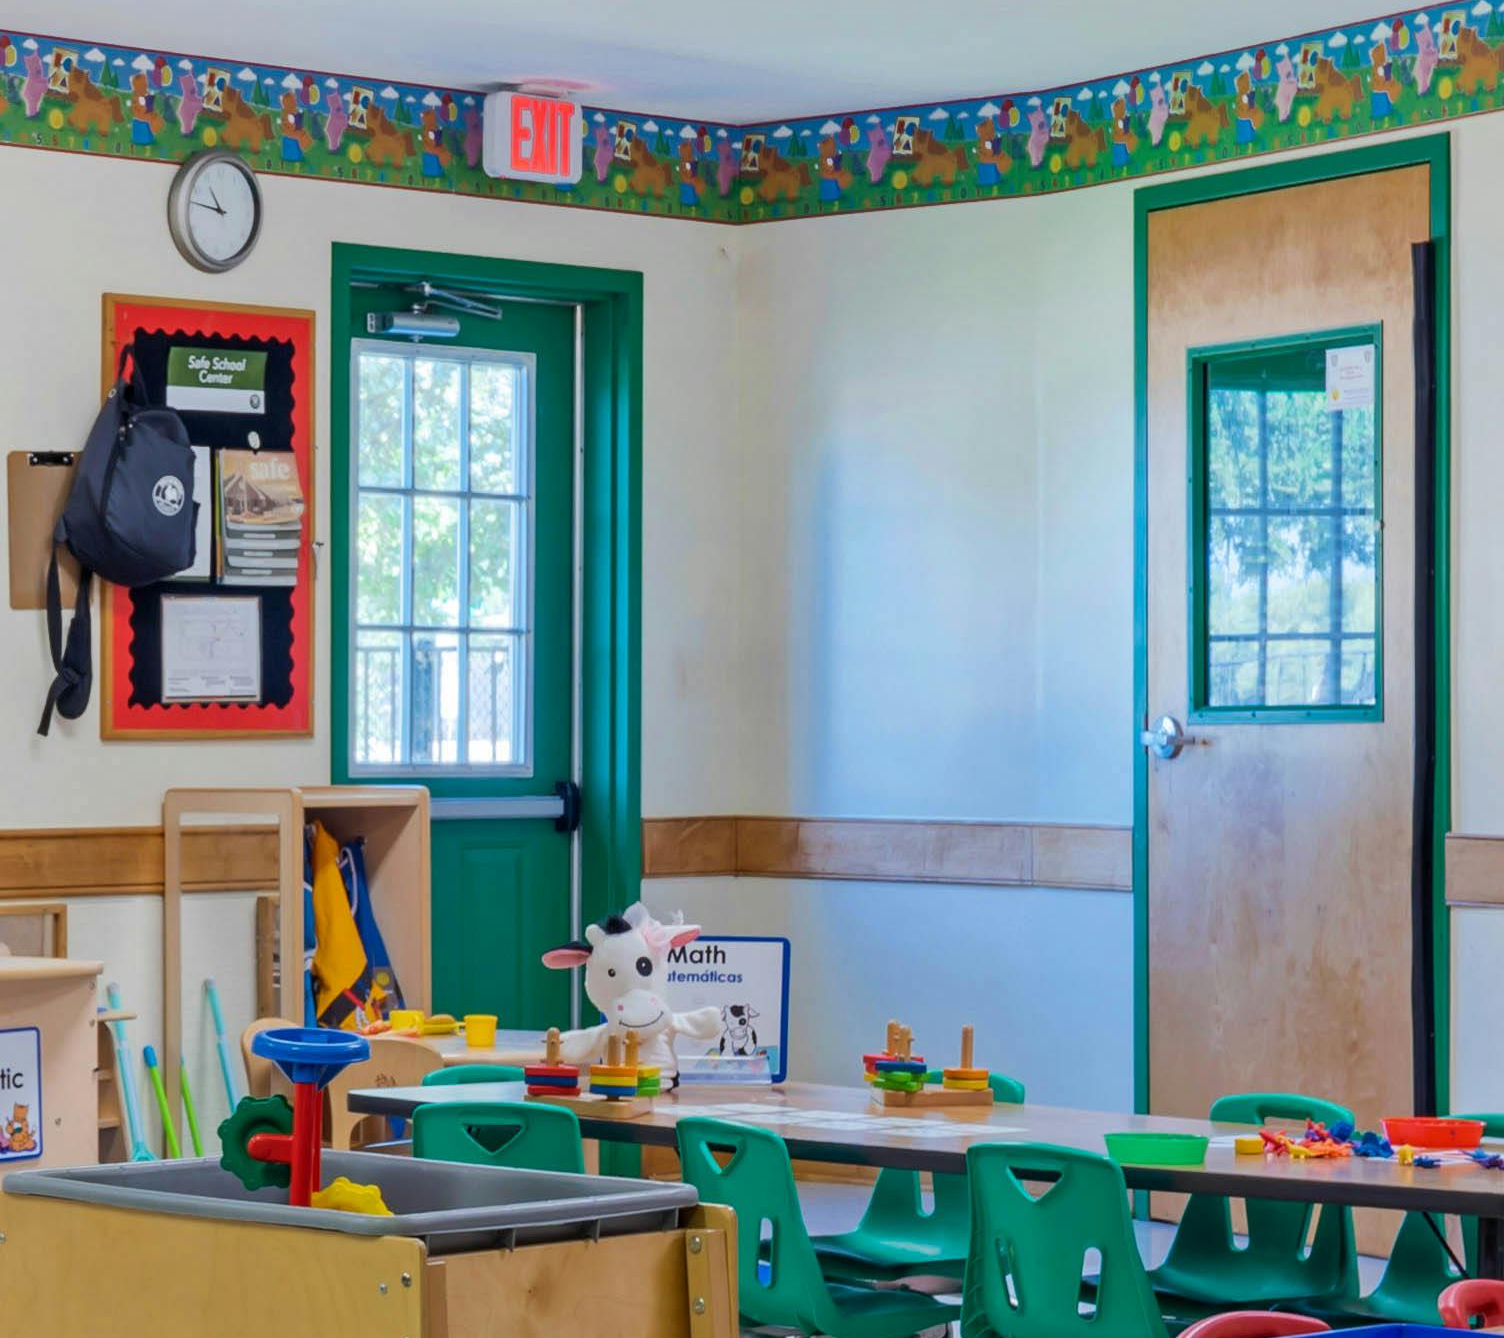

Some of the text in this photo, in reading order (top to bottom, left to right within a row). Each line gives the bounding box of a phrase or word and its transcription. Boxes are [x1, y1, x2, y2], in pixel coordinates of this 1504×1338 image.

[511, 94, 575, 177] EXIT
[188, 355, 246, 371] Safe School
[198, 369, 233, 384] Center
[249, 457, 289, 479] safe
[667, 945, 726, 964] Math
[667, 969, 743, 983] temáticas
